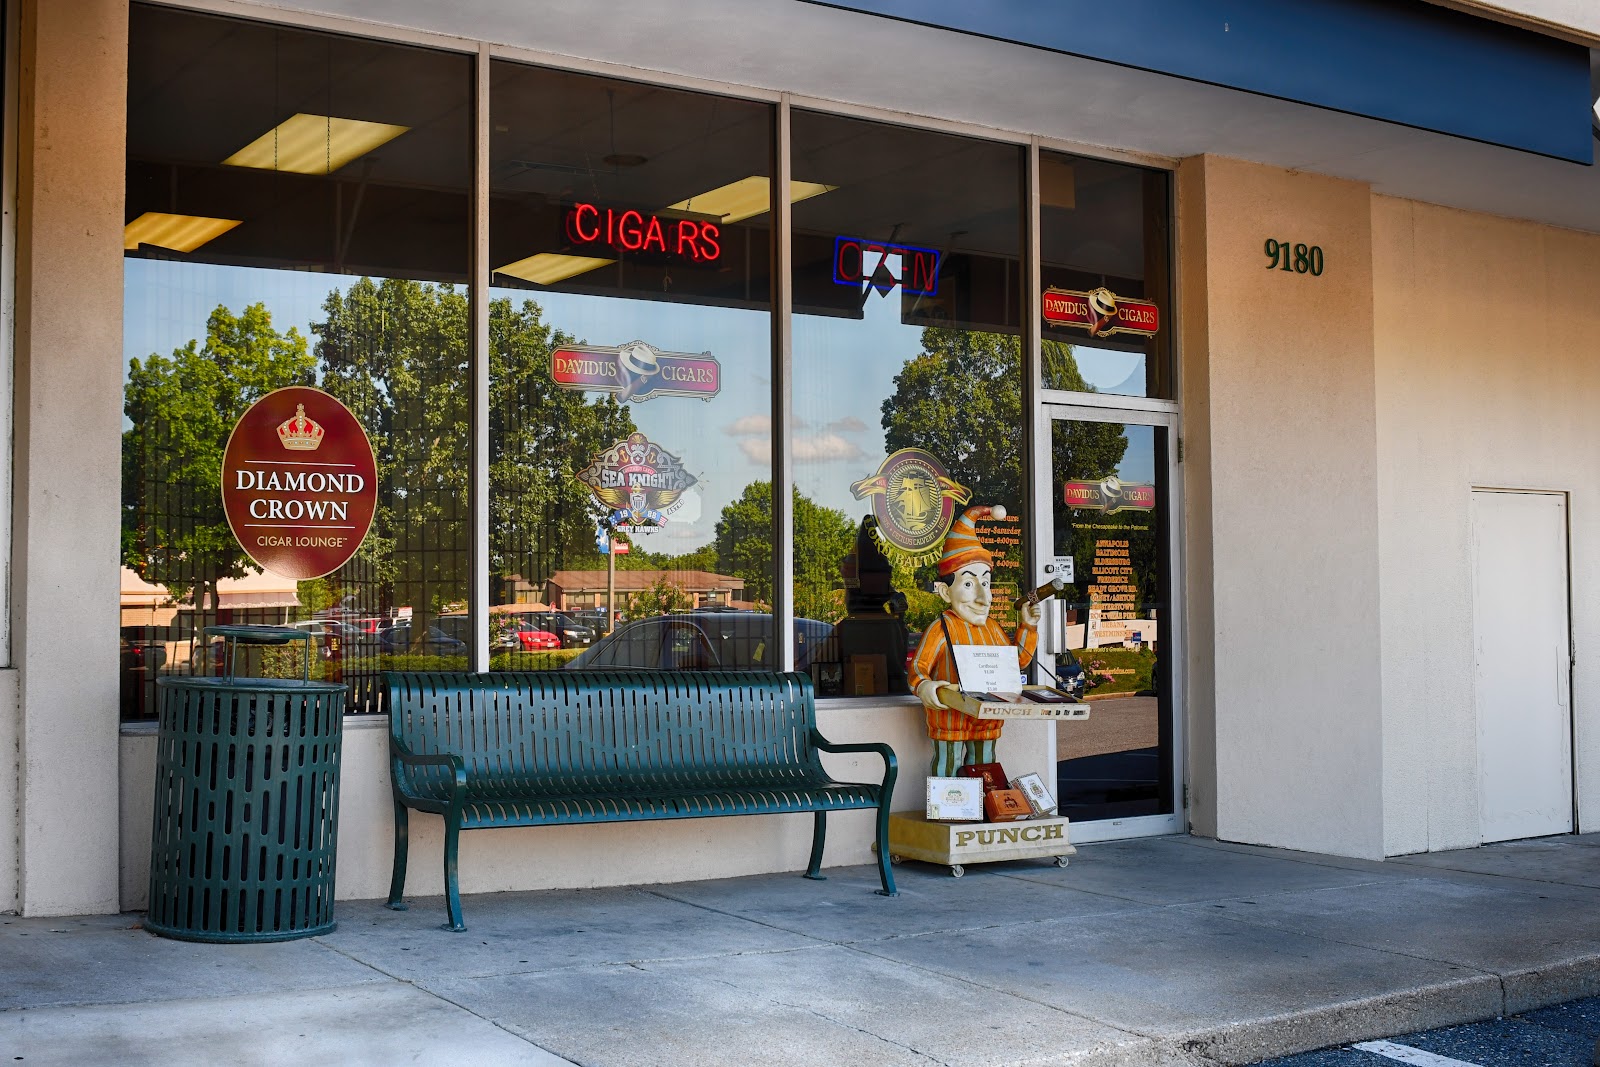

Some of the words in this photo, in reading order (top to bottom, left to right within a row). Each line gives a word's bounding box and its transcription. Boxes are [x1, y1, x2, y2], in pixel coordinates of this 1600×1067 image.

[575, 204, 720, 261] CIGARS
[1265, 238, 1323, 276] 9180
[1045, 299, 1088, 316] DAVIDUS
[1118, 308, 1155, 324] CIGARS
[555, 358, 617, 377] DAVIDUS
[661, 365, 714, 384] CIGARS
[236, 470, 364, 493] DIAMOND
[601, 469, 625, 489] SEA
[629, 471, 675, 490] KNIGHT
[1067, 488, 1100, 500] DAVIDUS
[1123, 490, 1153, 501] CIGARS
[250, 499, 348, 521] CROWN
[620, 509, 628, 518] 19
[257, 535, 292, 547] CIGAR
[296, 536, 343, 548] LOUNGE
[864, 518, 891, 557] LORD
[1096, 540, 1129, 548] ANNAPOLIS
[1096, 549, 1129, 557] BALTIMORE
[1092, 567, 1119, 575] ELLICOTT
[1120, 567, 1133, 575] CITY
[1097, 576, 1128, 584] FREDERICK
[1088, 585, 1107, 593] SHADY
[1108, 585, 1127, 593] GROVE
[1101, 621, 1124, 629] URBANA
[983, 707, 1032, 716] PUNCH
[956, 823, 1064, 848] PUNCH
